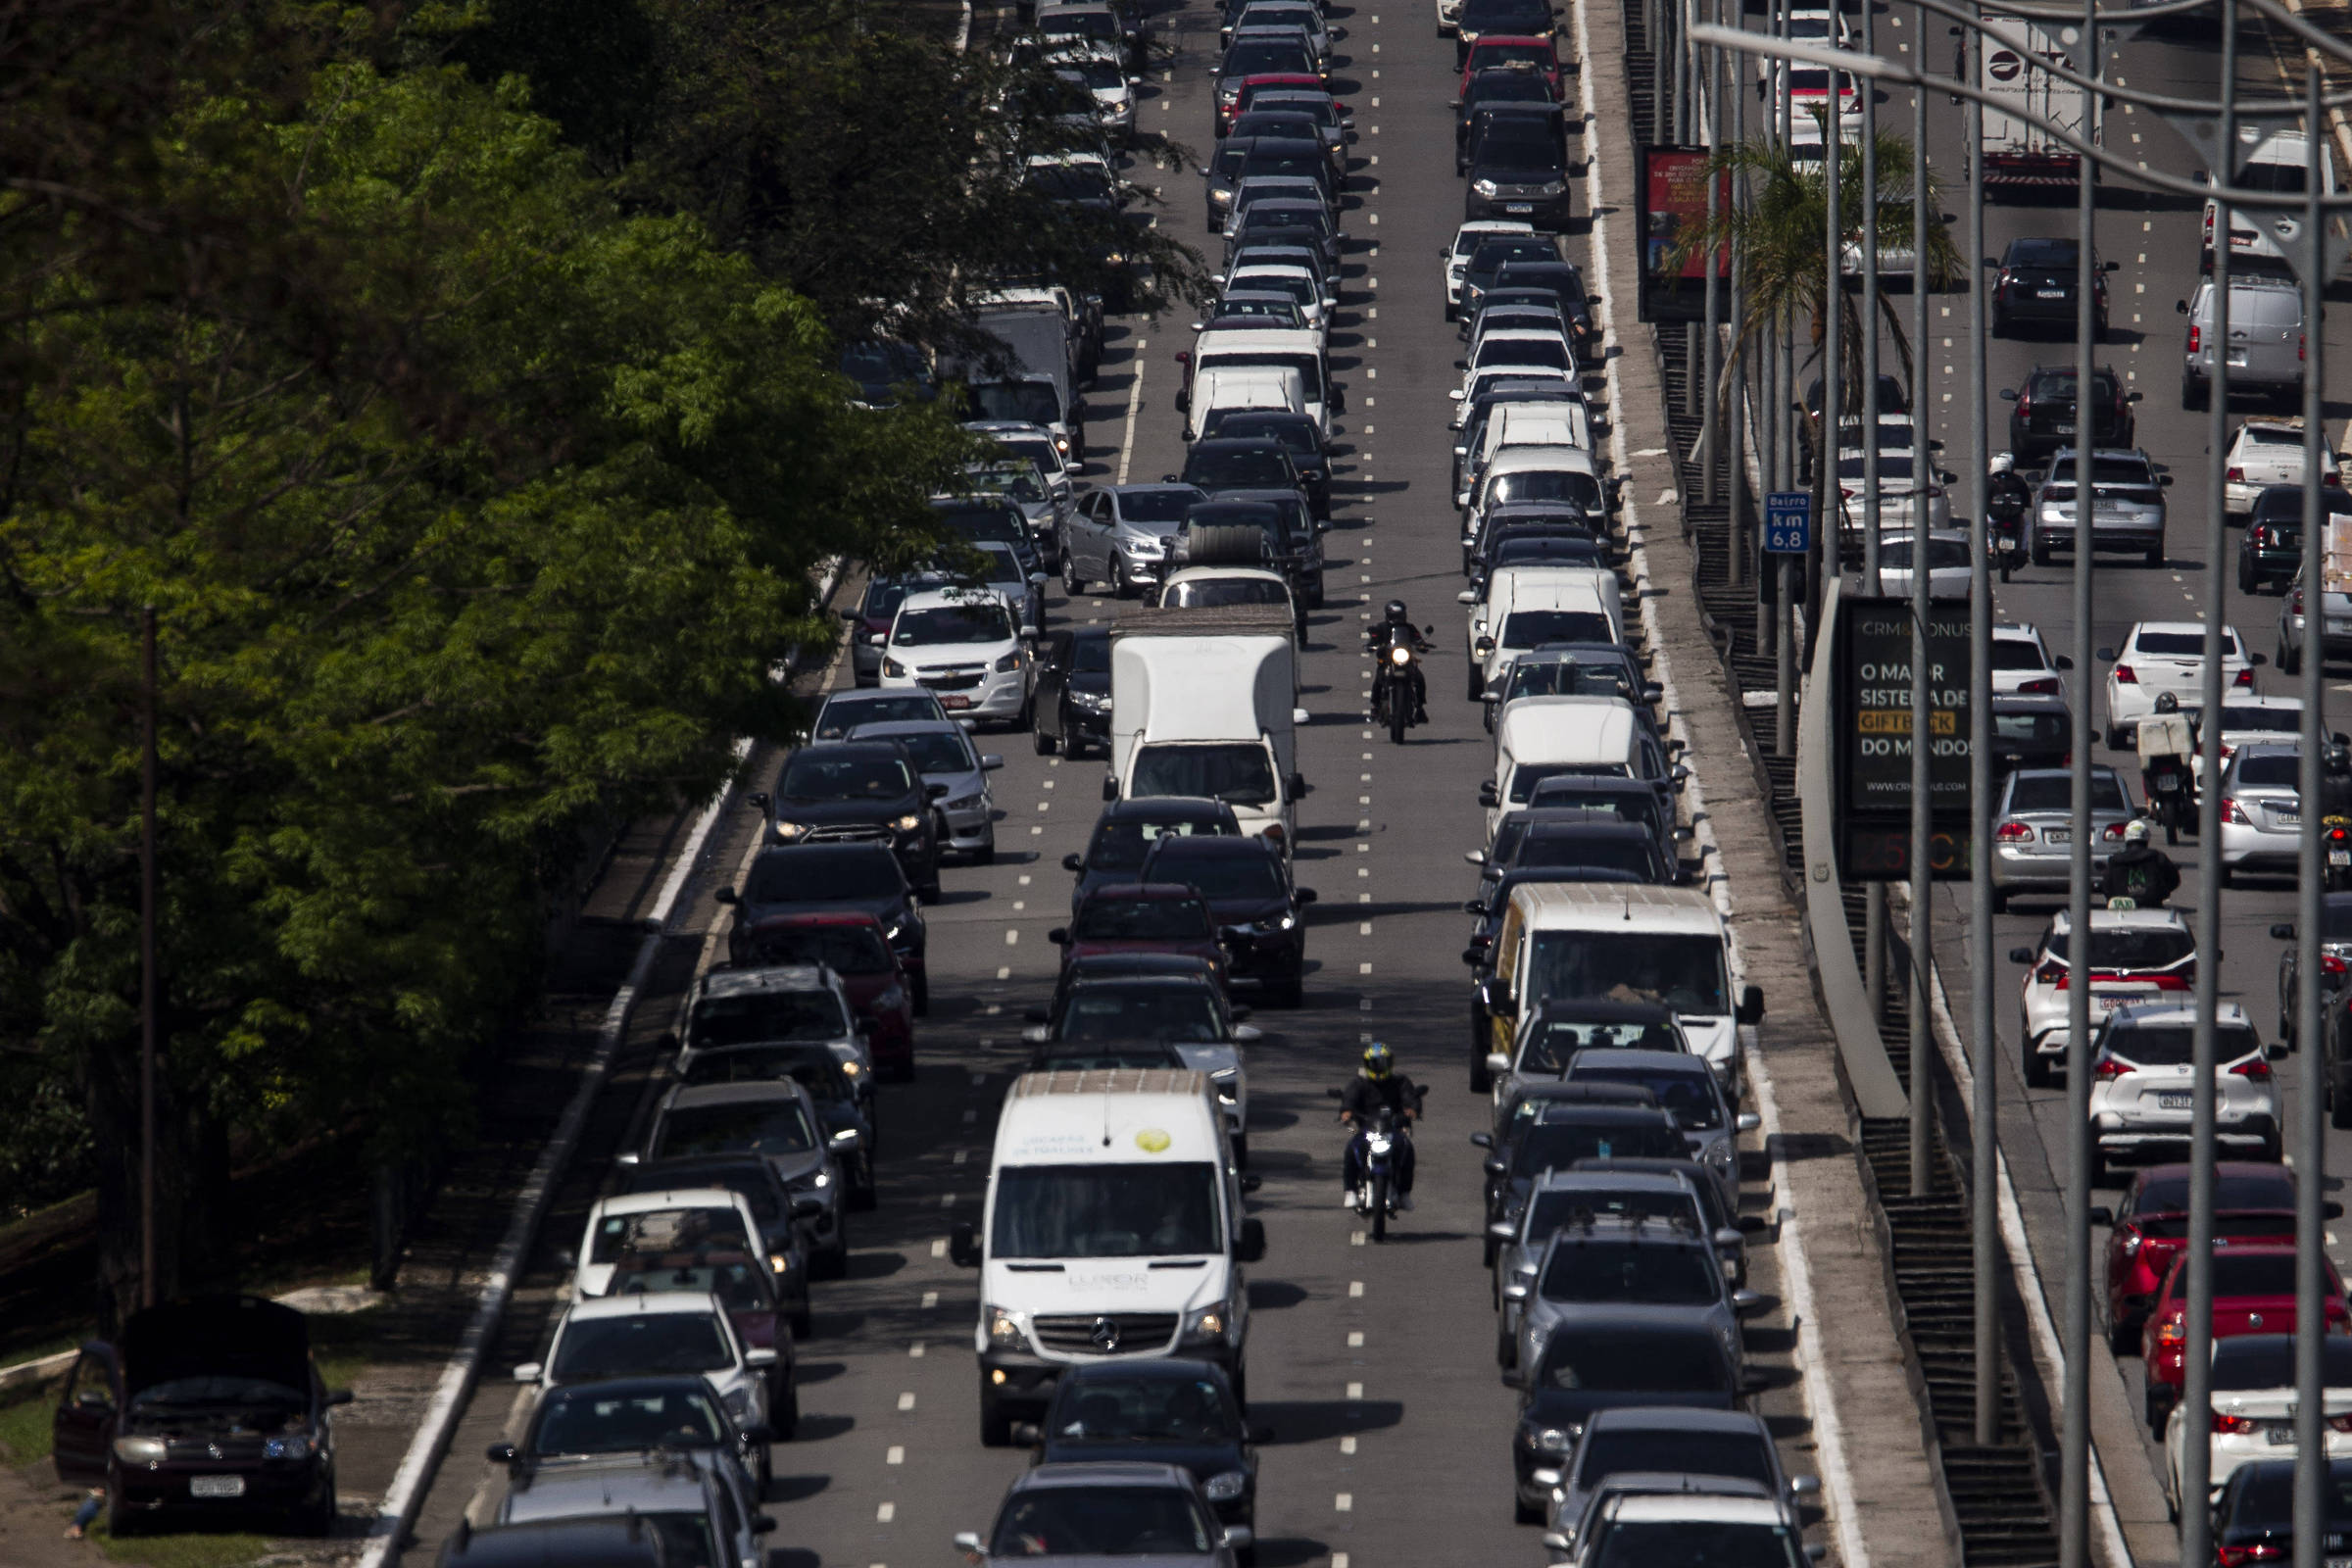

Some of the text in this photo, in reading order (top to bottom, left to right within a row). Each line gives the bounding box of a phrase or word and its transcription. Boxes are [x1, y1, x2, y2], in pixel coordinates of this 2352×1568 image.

[1770, 496, 1807, 507] Bairro
[1772, 512, 1802, 527] km
[1772, 530, 1802, 549] 6,8
[1861, 663, 1944, 681] O MAR
[1860, 689, 1968, 708] SISTEA DE
[1862, 738, 1890, 756] DO
